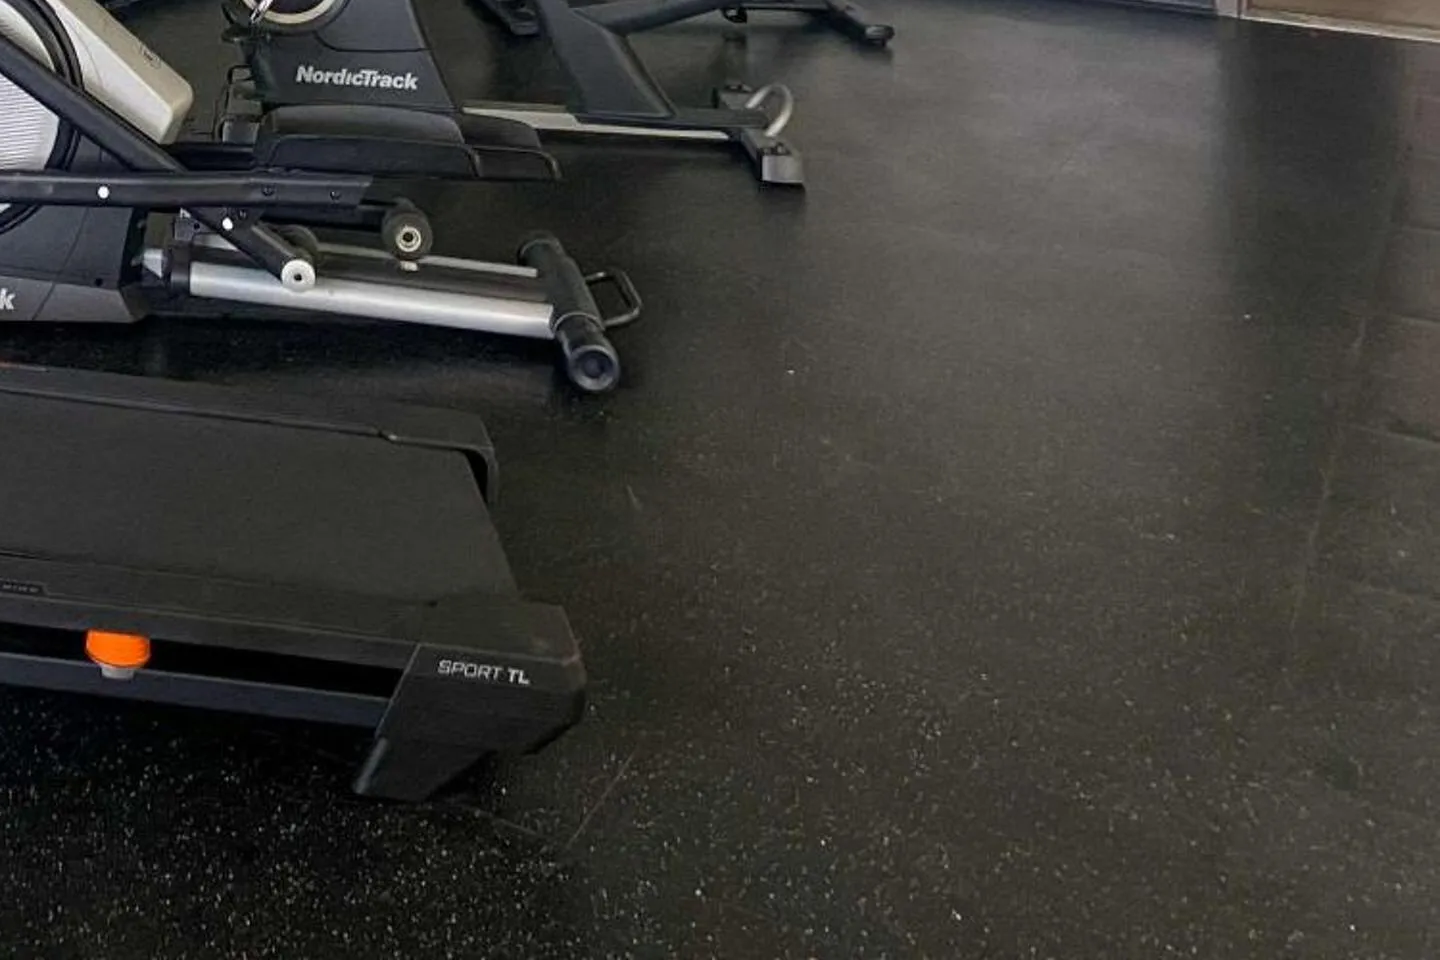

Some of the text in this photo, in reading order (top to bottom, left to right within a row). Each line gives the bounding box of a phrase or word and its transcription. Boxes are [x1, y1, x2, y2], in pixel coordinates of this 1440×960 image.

[295, 64, 418, 90] NordicTrack
[438, 659, 530, 685] SPORT TL
